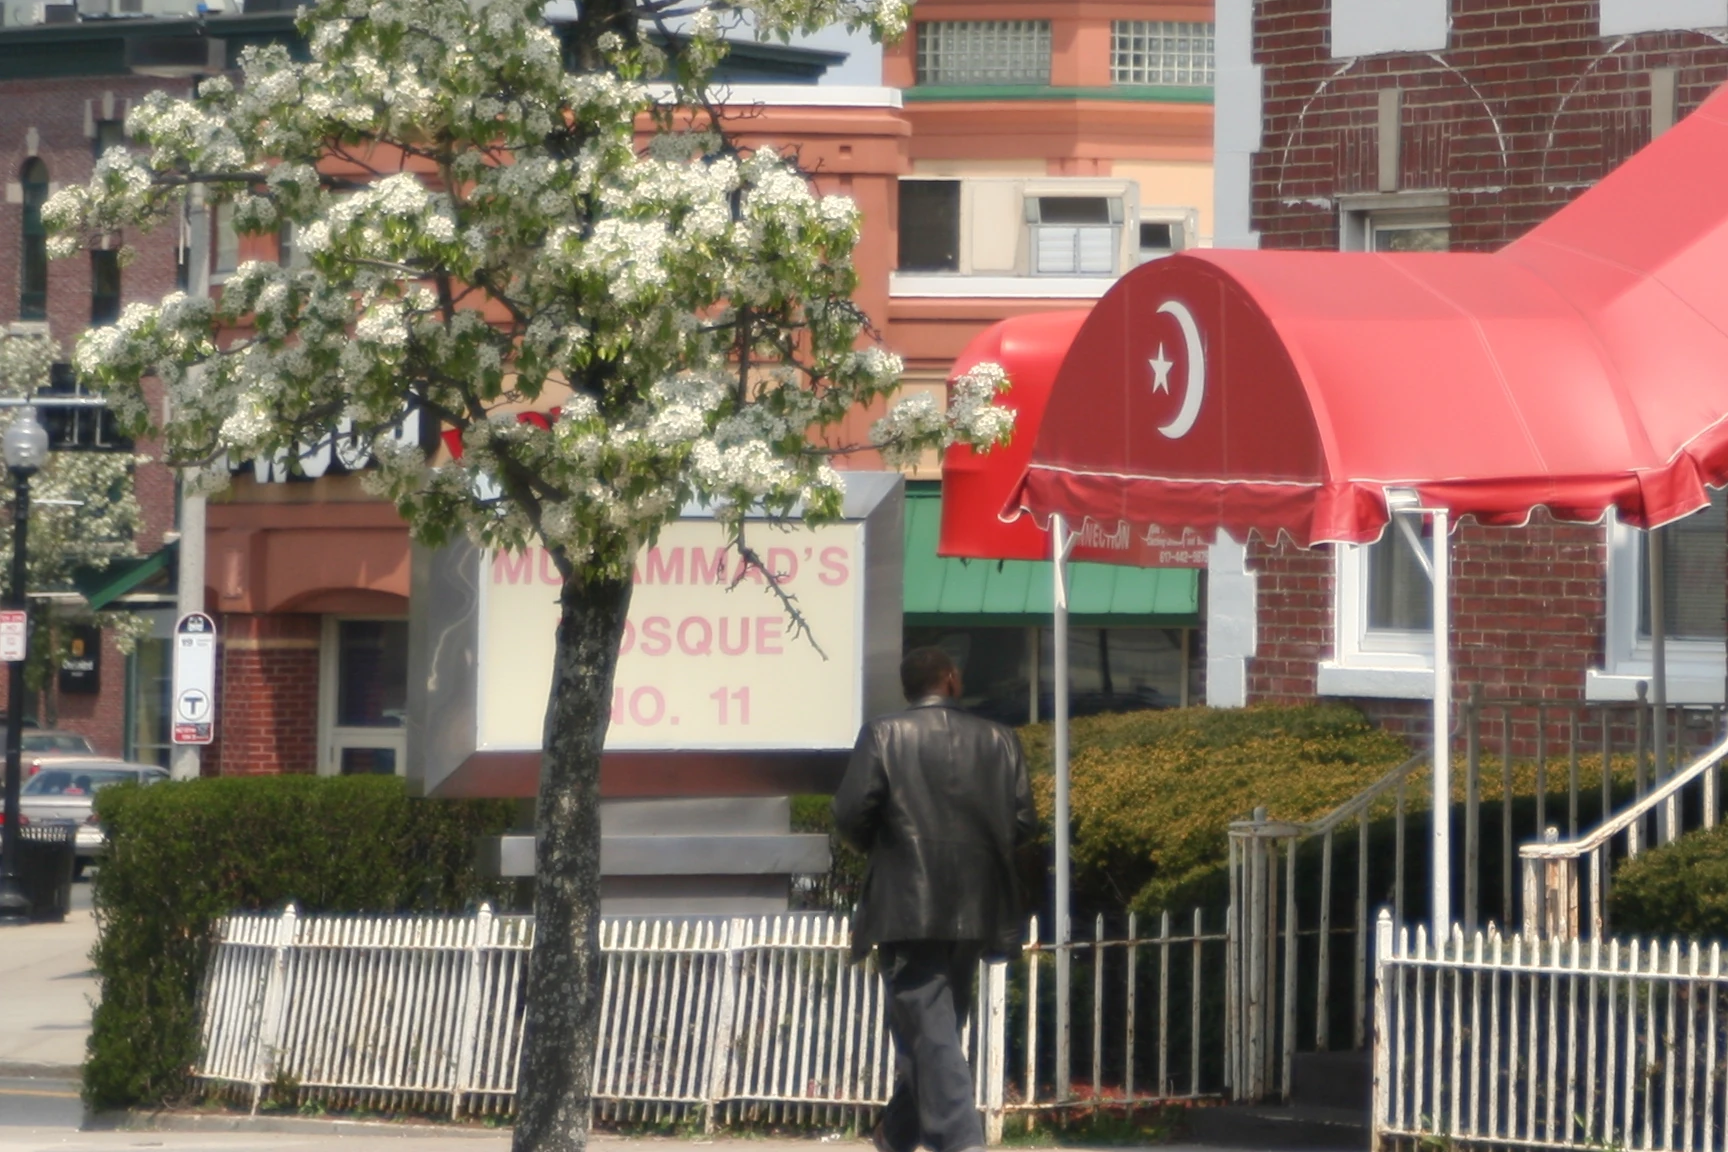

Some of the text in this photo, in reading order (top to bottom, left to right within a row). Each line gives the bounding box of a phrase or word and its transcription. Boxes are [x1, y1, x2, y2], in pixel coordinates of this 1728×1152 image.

[493, 546, 849, 586] MUMMAD'S
[556, 616, 784, 656] SQUE
[709, 686, 751, 726] 11
